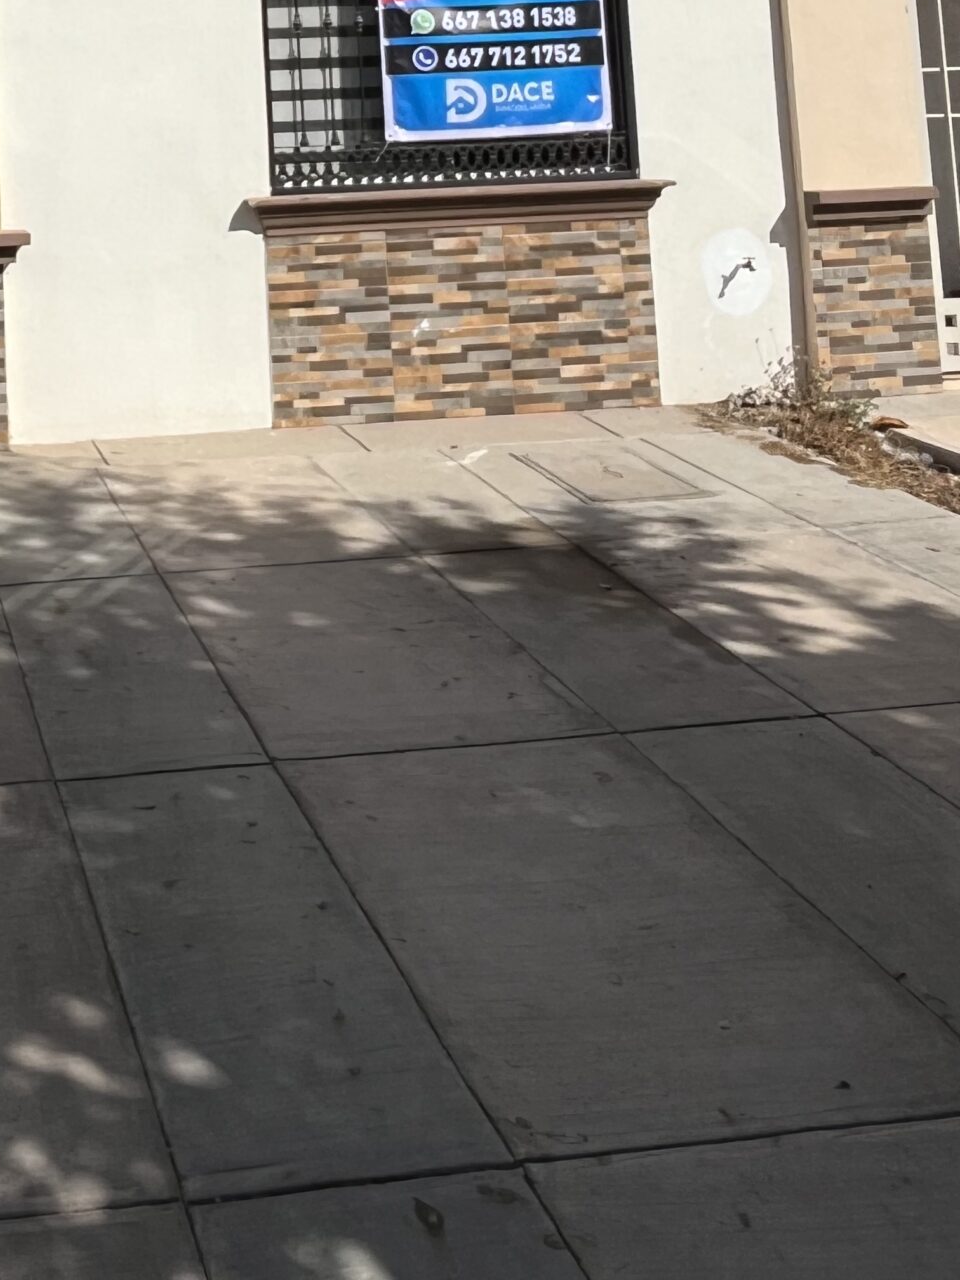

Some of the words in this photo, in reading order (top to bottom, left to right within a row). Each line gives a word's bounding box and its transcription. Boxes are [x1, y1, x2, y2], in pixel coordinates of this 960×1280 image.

[441, 11, 478, 31] 667
[486, 10, 525, 29] 138
[530, 7, 577, 28] 1538
[445, 48, 483, 69] 667
[488, 46, 526, 66] 712
[531, 43, 582, 64] 1752
[492, 80, 555, 103] DACE
